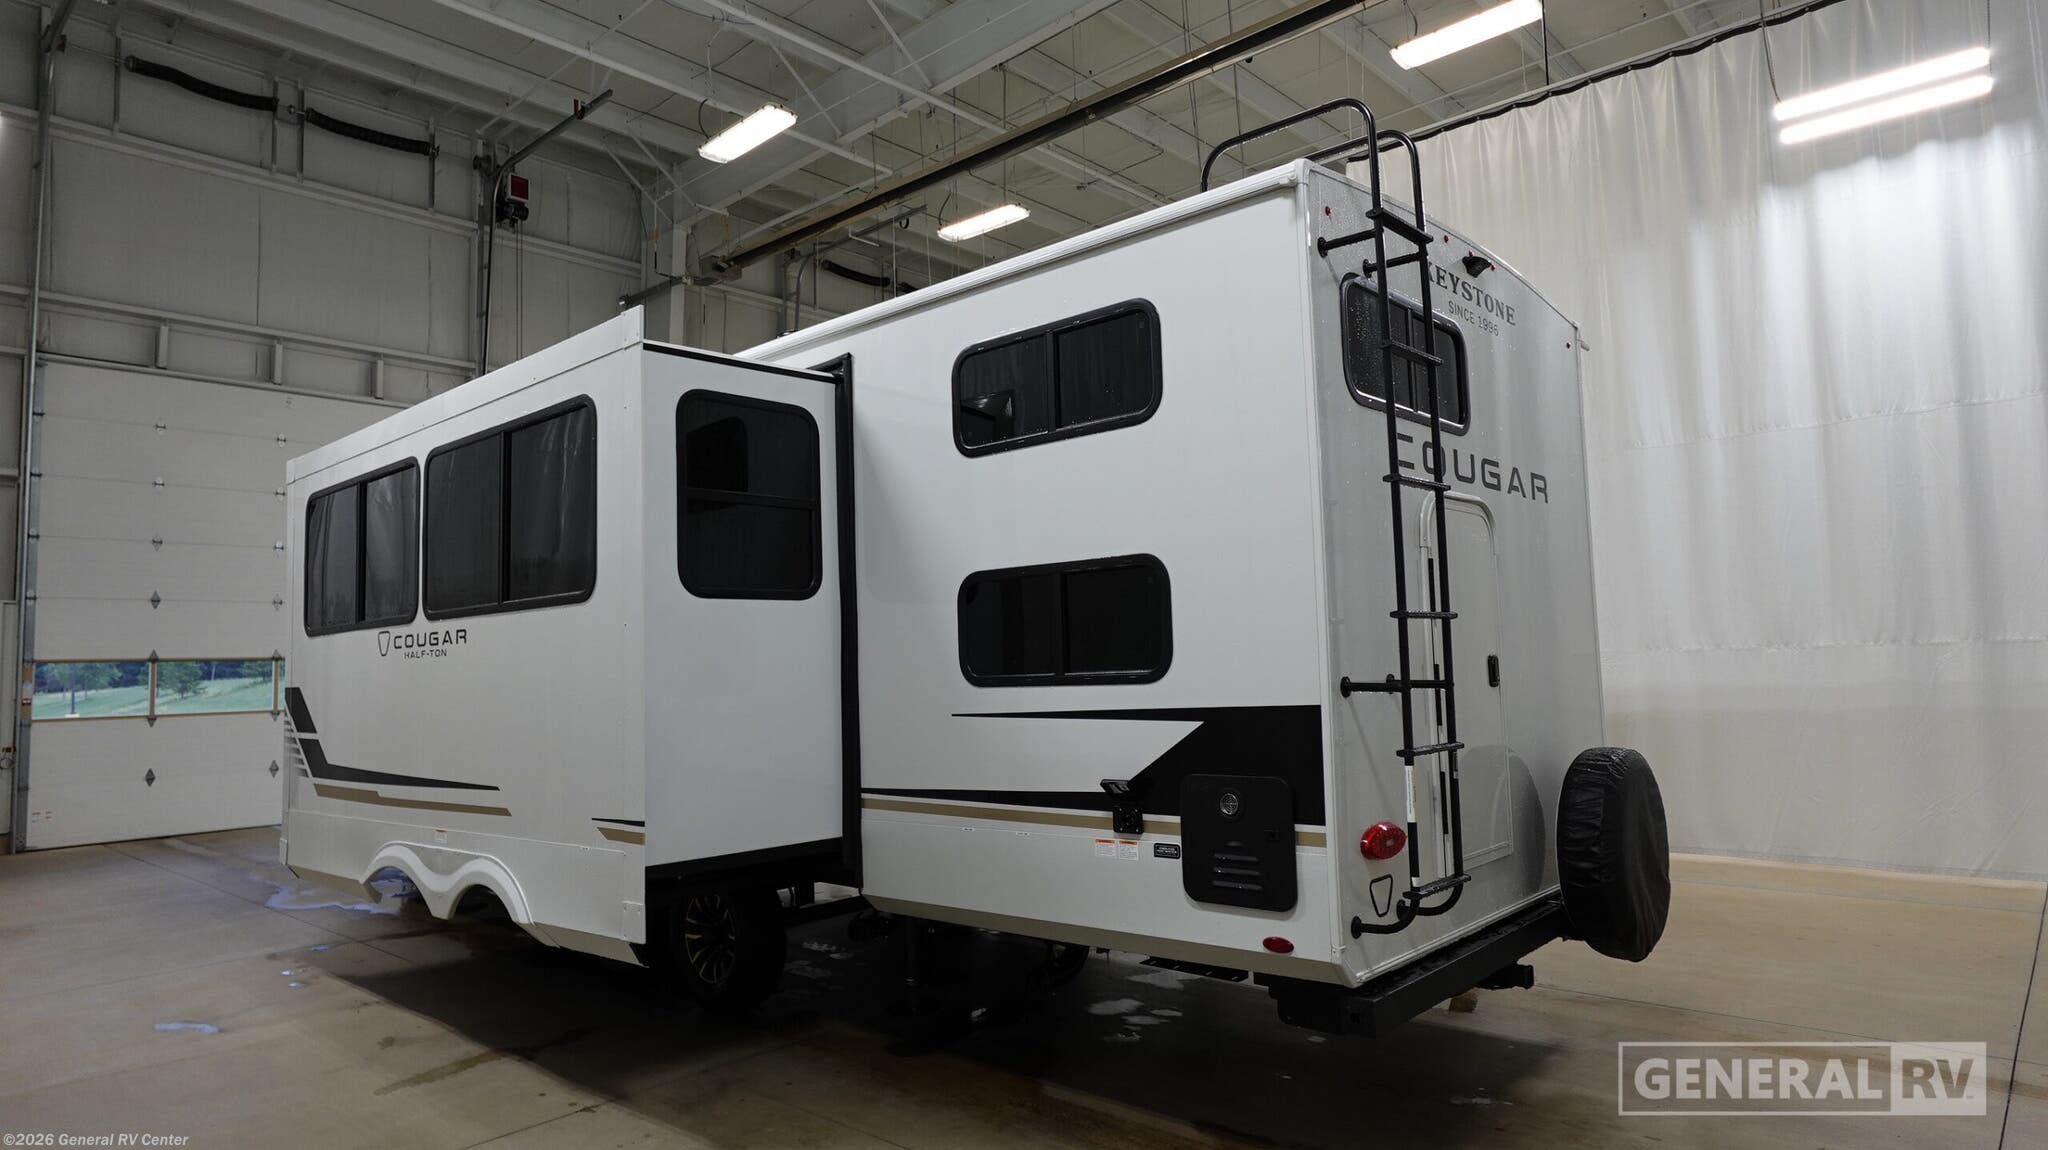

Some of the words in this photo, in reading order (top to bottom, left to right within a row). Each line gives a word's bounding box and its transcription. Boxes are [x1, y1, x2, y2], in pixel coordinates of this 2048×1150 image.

[1448, 300, 1475, 325] SINCE
[393, 628, 467, 650] COUGAR
[403, 648, 448, 660] HALF-TON
